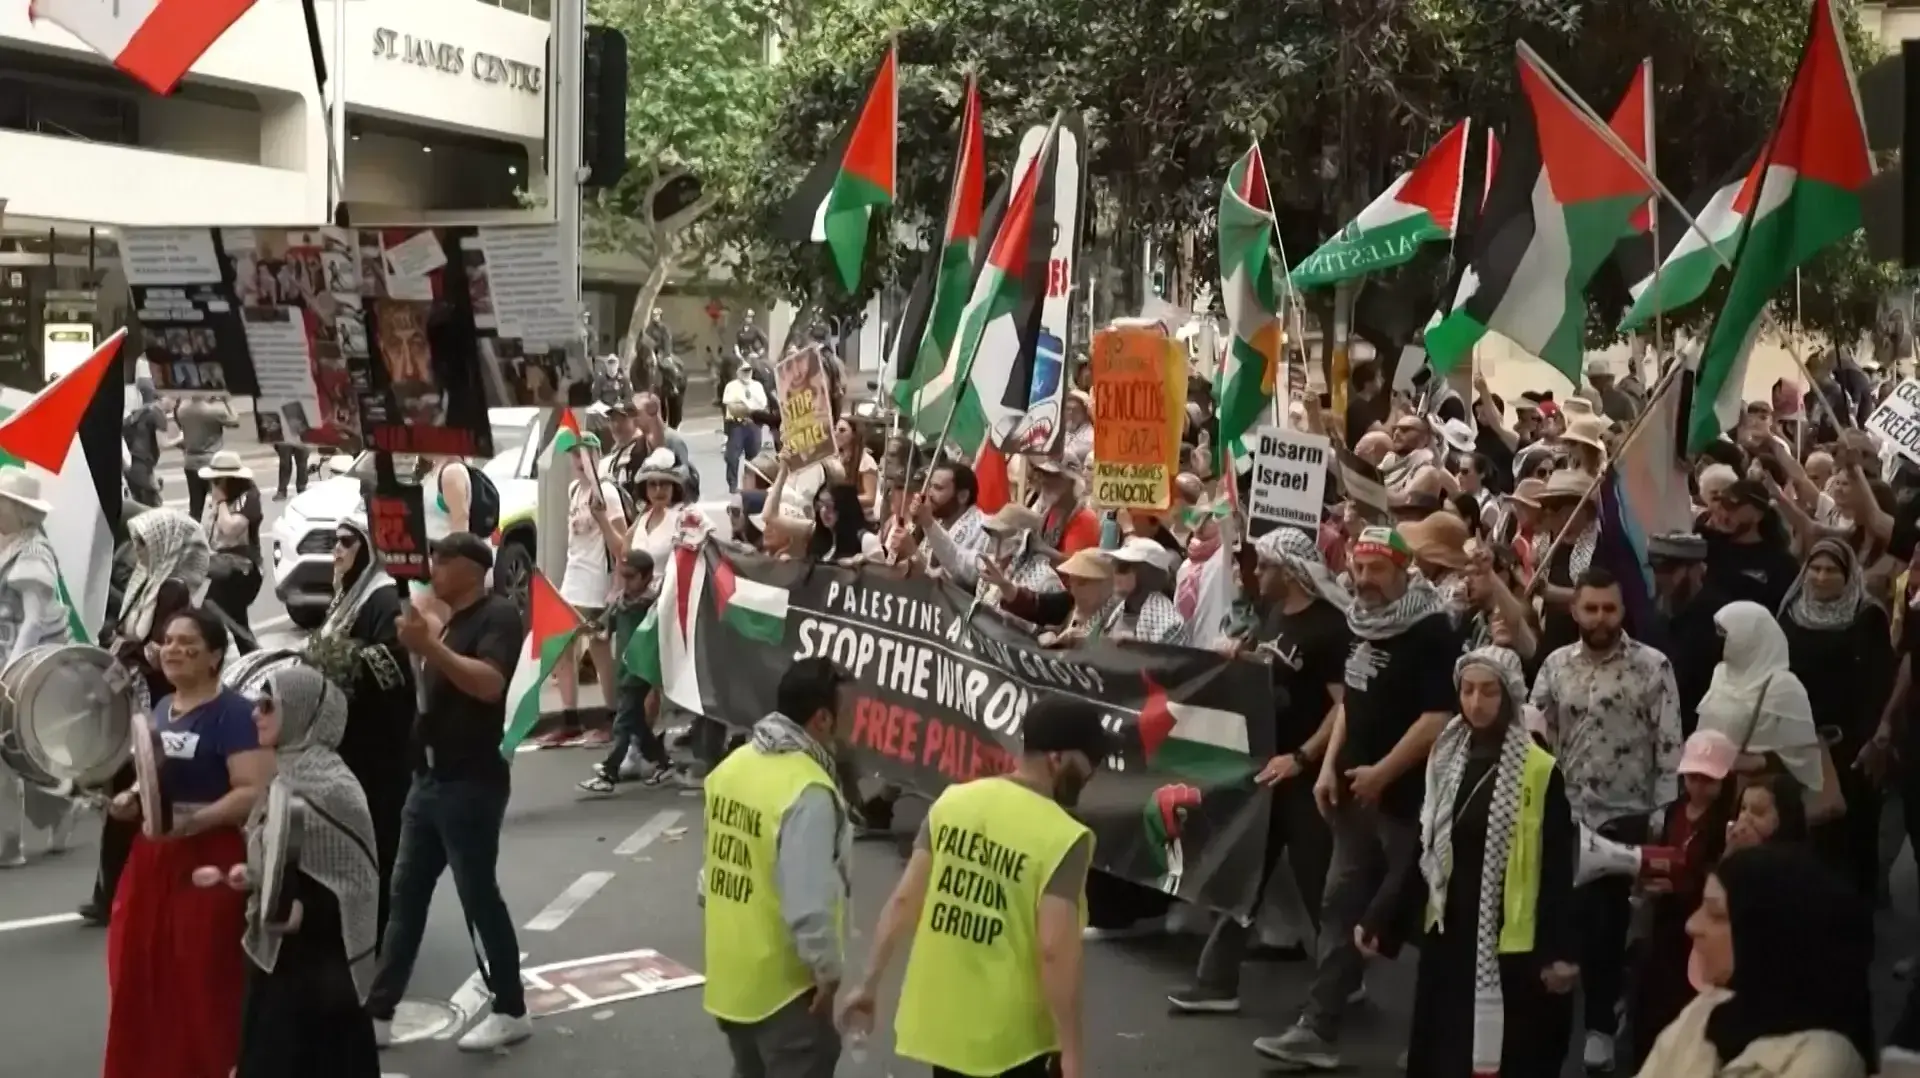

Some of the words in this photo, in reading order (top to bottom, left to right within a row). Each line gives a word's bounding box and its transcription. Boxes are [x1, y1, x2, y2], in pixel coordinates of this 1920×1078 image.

[402, 33, 465, 75] JAMES
[471, 51, 542, 95] CENTRE
[782, 388, 814, 421] STOP
[1096, 379, 1167, 425] GENOCIDE
[1117, 426, 1162, 457] GAZA
[1259, 435, 1323, 466] Disarm
[1099, 481, 1158, 504] GENOCIDE
[1256, 463, 1309, 492] Israel
[1253, 501, 1317, 524] Palestinians
[827, 580, 943, 635] PALESTINE
[1019, 649, 1105, 694] GROUP
[935, 653, 990, 722] WAR
[851, 696, 922, 763] FREE
[937, 823, 1028, 884] PALESTINE
[937, 866, 1008, 912] ACTION
[931, 901, 1004, 946] GROUP
